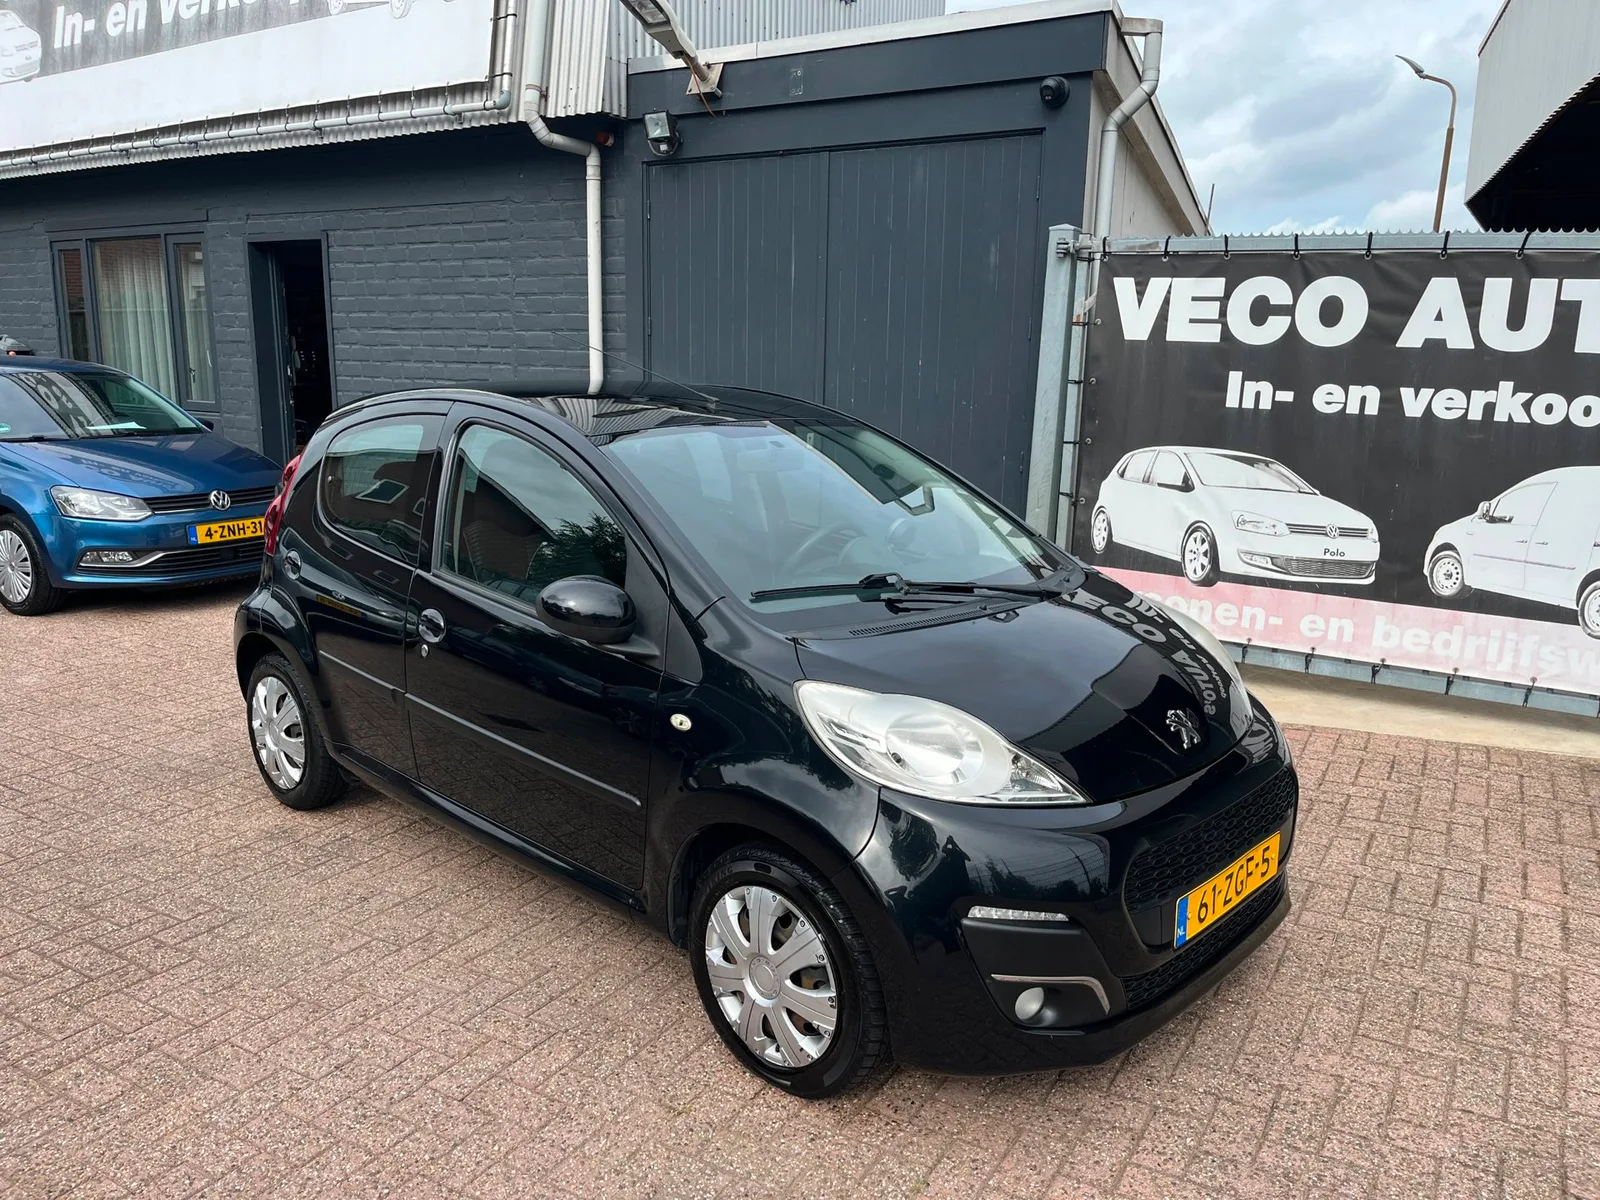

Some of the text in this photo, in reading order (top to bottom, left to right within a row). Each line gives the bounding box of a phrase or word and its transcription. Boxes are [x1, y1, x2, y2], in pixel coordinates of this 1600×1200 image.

[53, 6, 96, 49] In-
[105, 0, 148, 37] en
[1113, 275, 1369, 347] VECO
[1225, 371, 1600, 428] In- en verkoo
[204, 520, 263, 540] 4-ZNH-31
[1323, 547, 1346, 558] Polo
[1299, 613, 1354, 642] en
[1197, 845, 1271, 924] 61-ZGF-5
